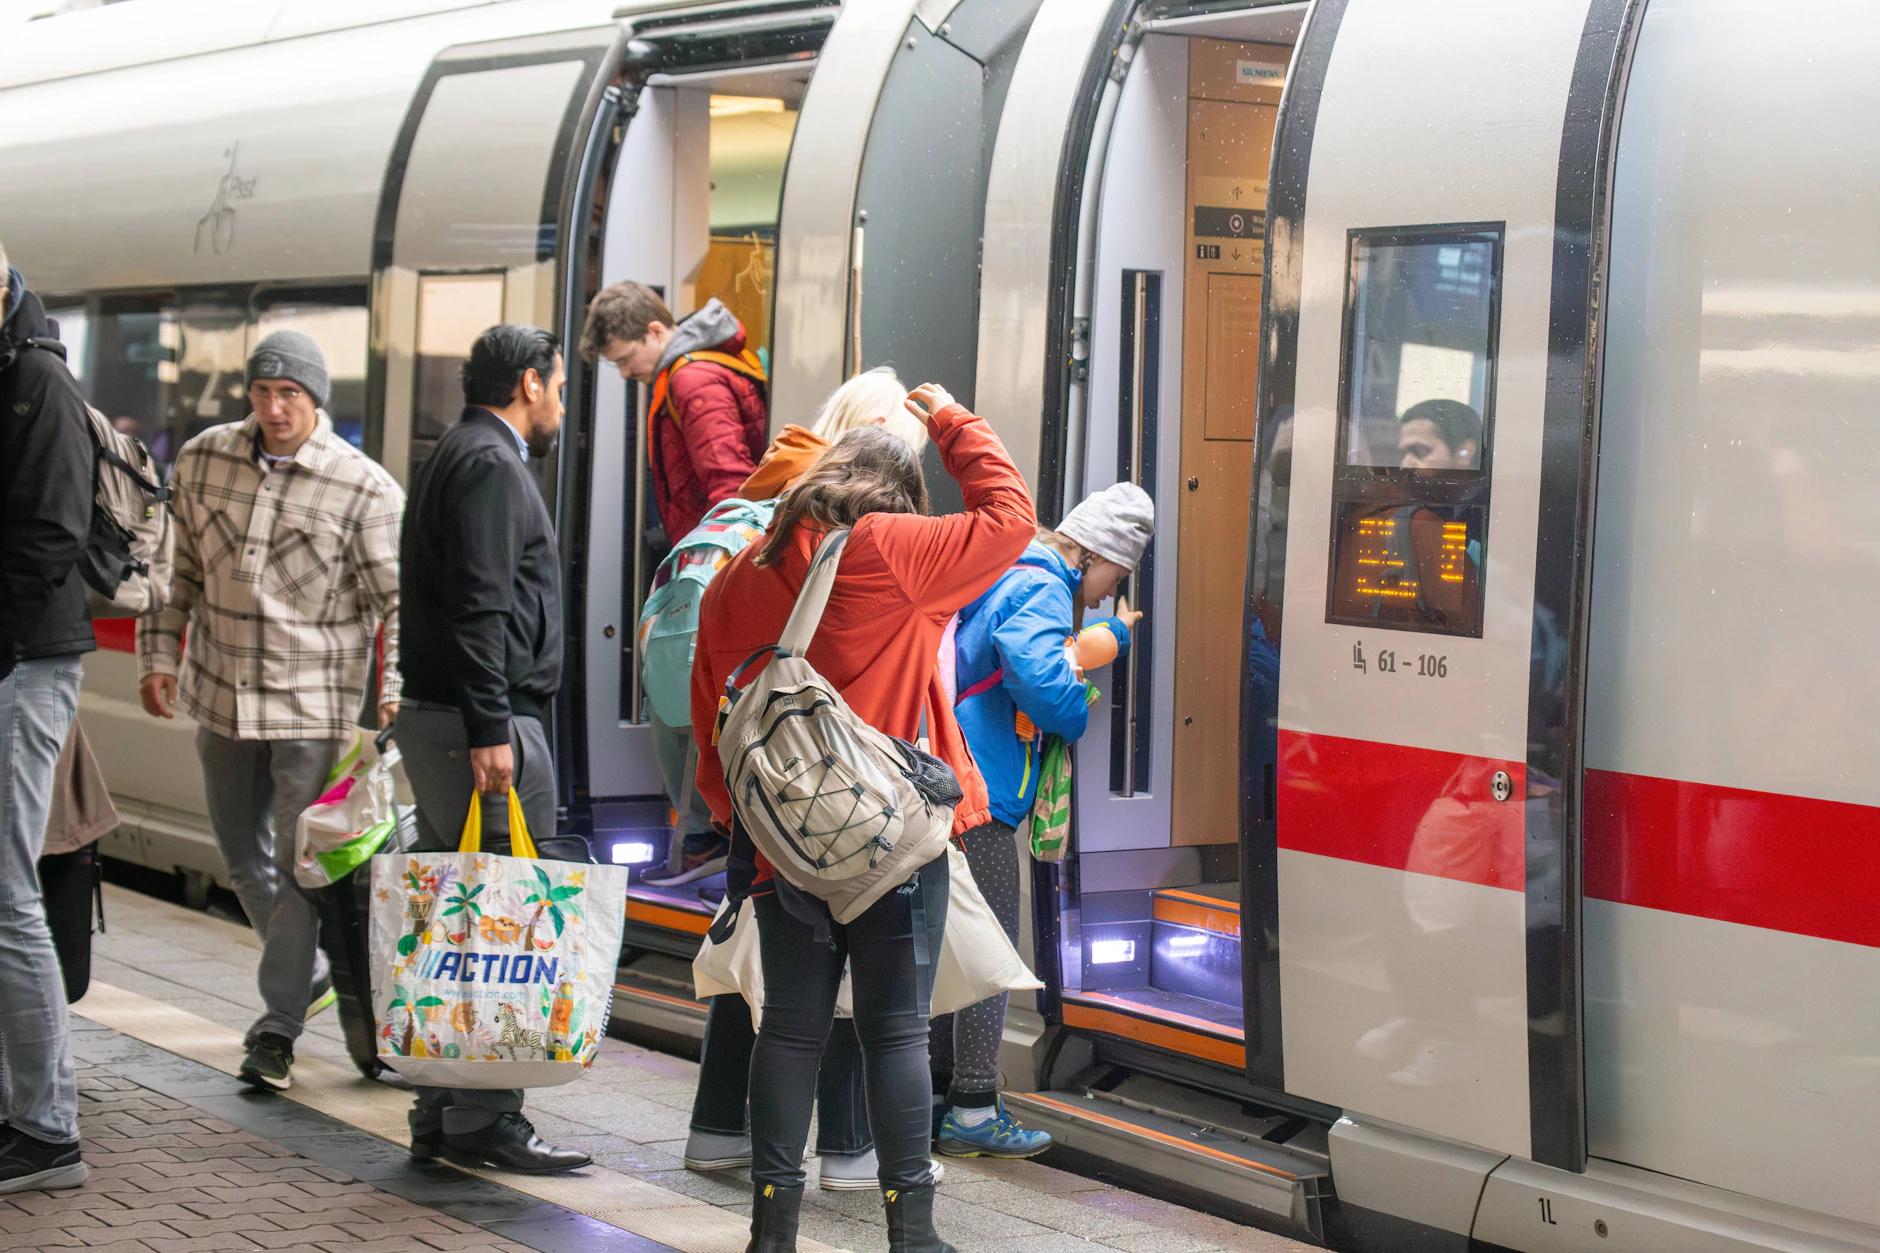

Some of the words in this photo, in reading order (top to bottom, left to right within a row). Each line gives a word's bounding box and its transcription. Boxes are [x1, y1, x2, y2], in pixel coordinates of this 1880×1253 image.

[1378, 649, 1396, 673] 61
[1417, 654, 1447, 678] 106
[433, 951, 559, 985] ACTION
[1538, 1197, 1557, 1226] 1L
